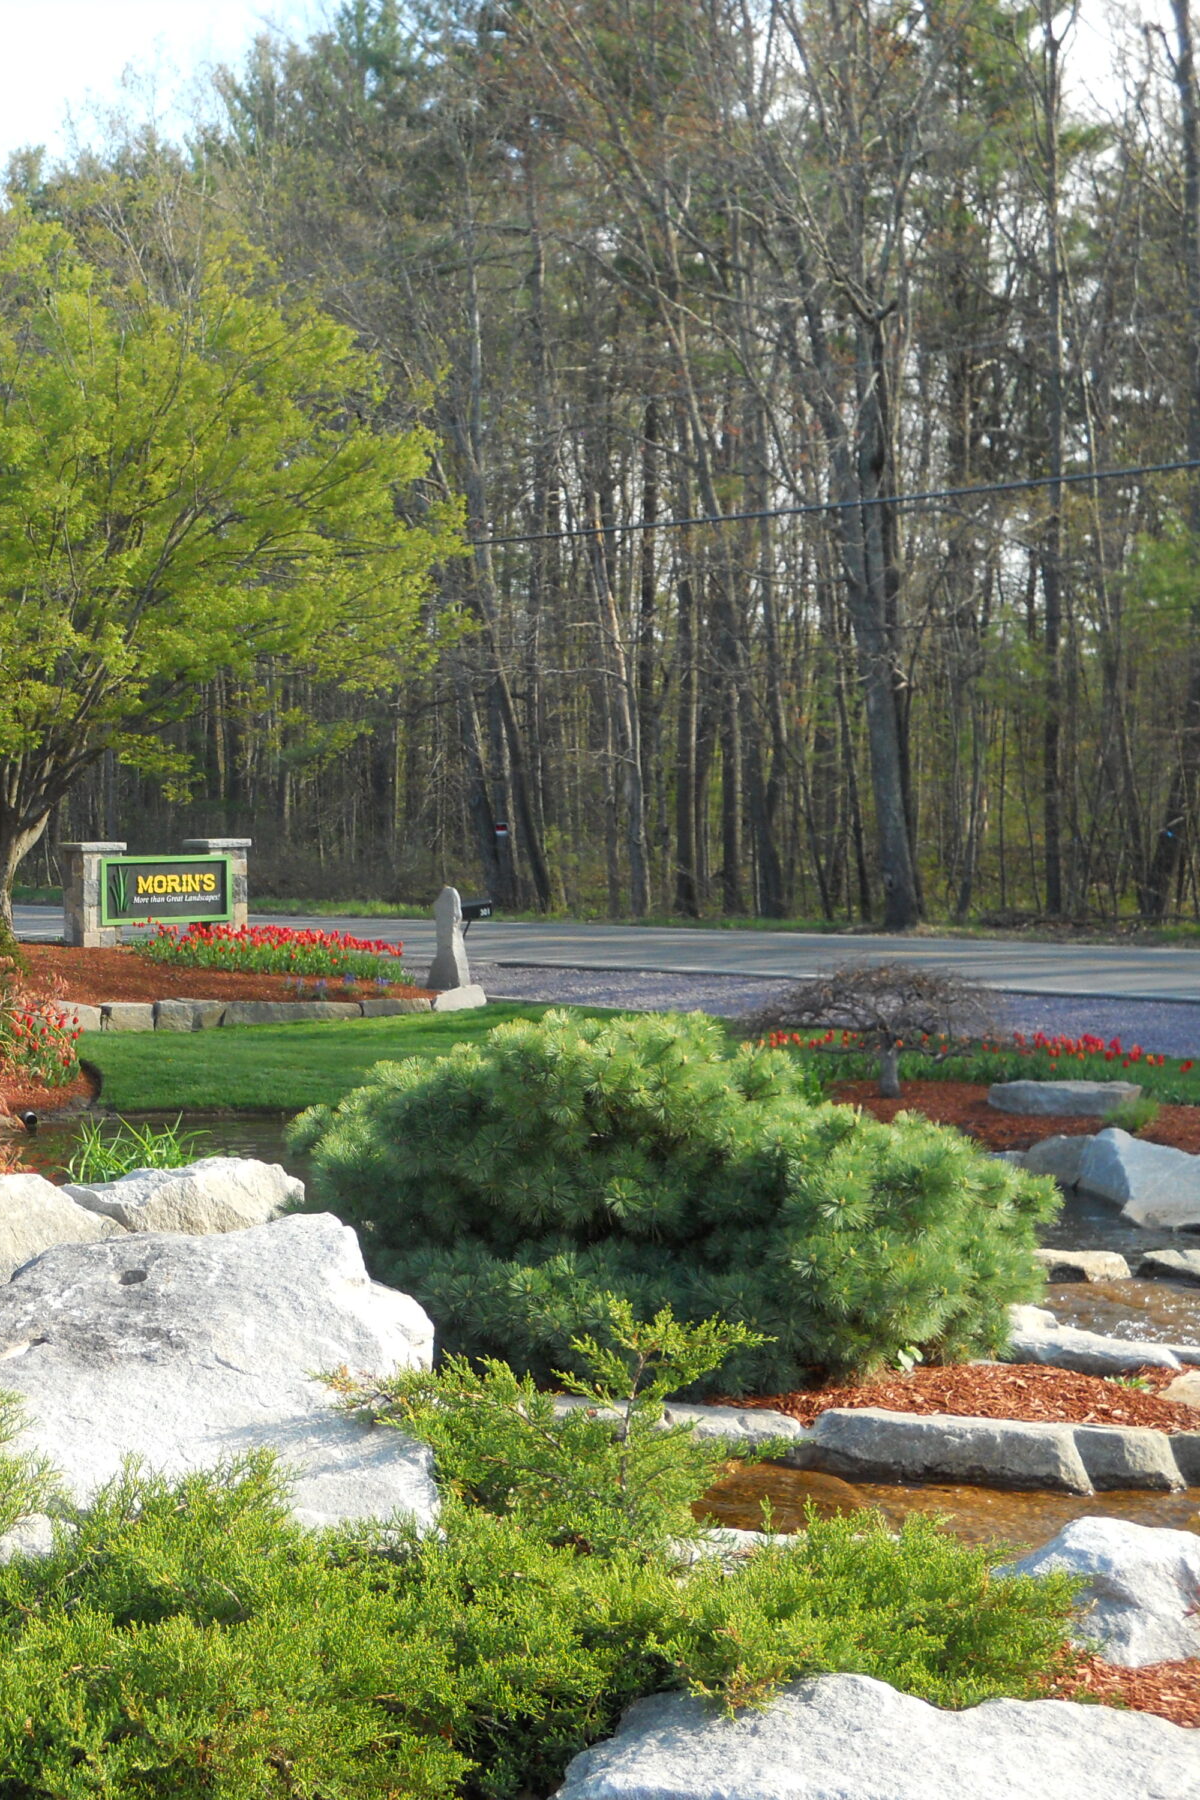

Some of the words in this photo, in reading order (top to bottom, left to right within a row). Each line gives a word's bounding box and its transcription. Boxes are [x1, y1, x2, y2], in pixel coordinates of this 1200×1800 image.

[137, 873, 216, 894] MORIN'S
[133, 895, 149, 904] More
[150, 895, 165, 903] than
[166, 894, 183, 903] Great
[184, 893, 220, 902] Landscapes!
